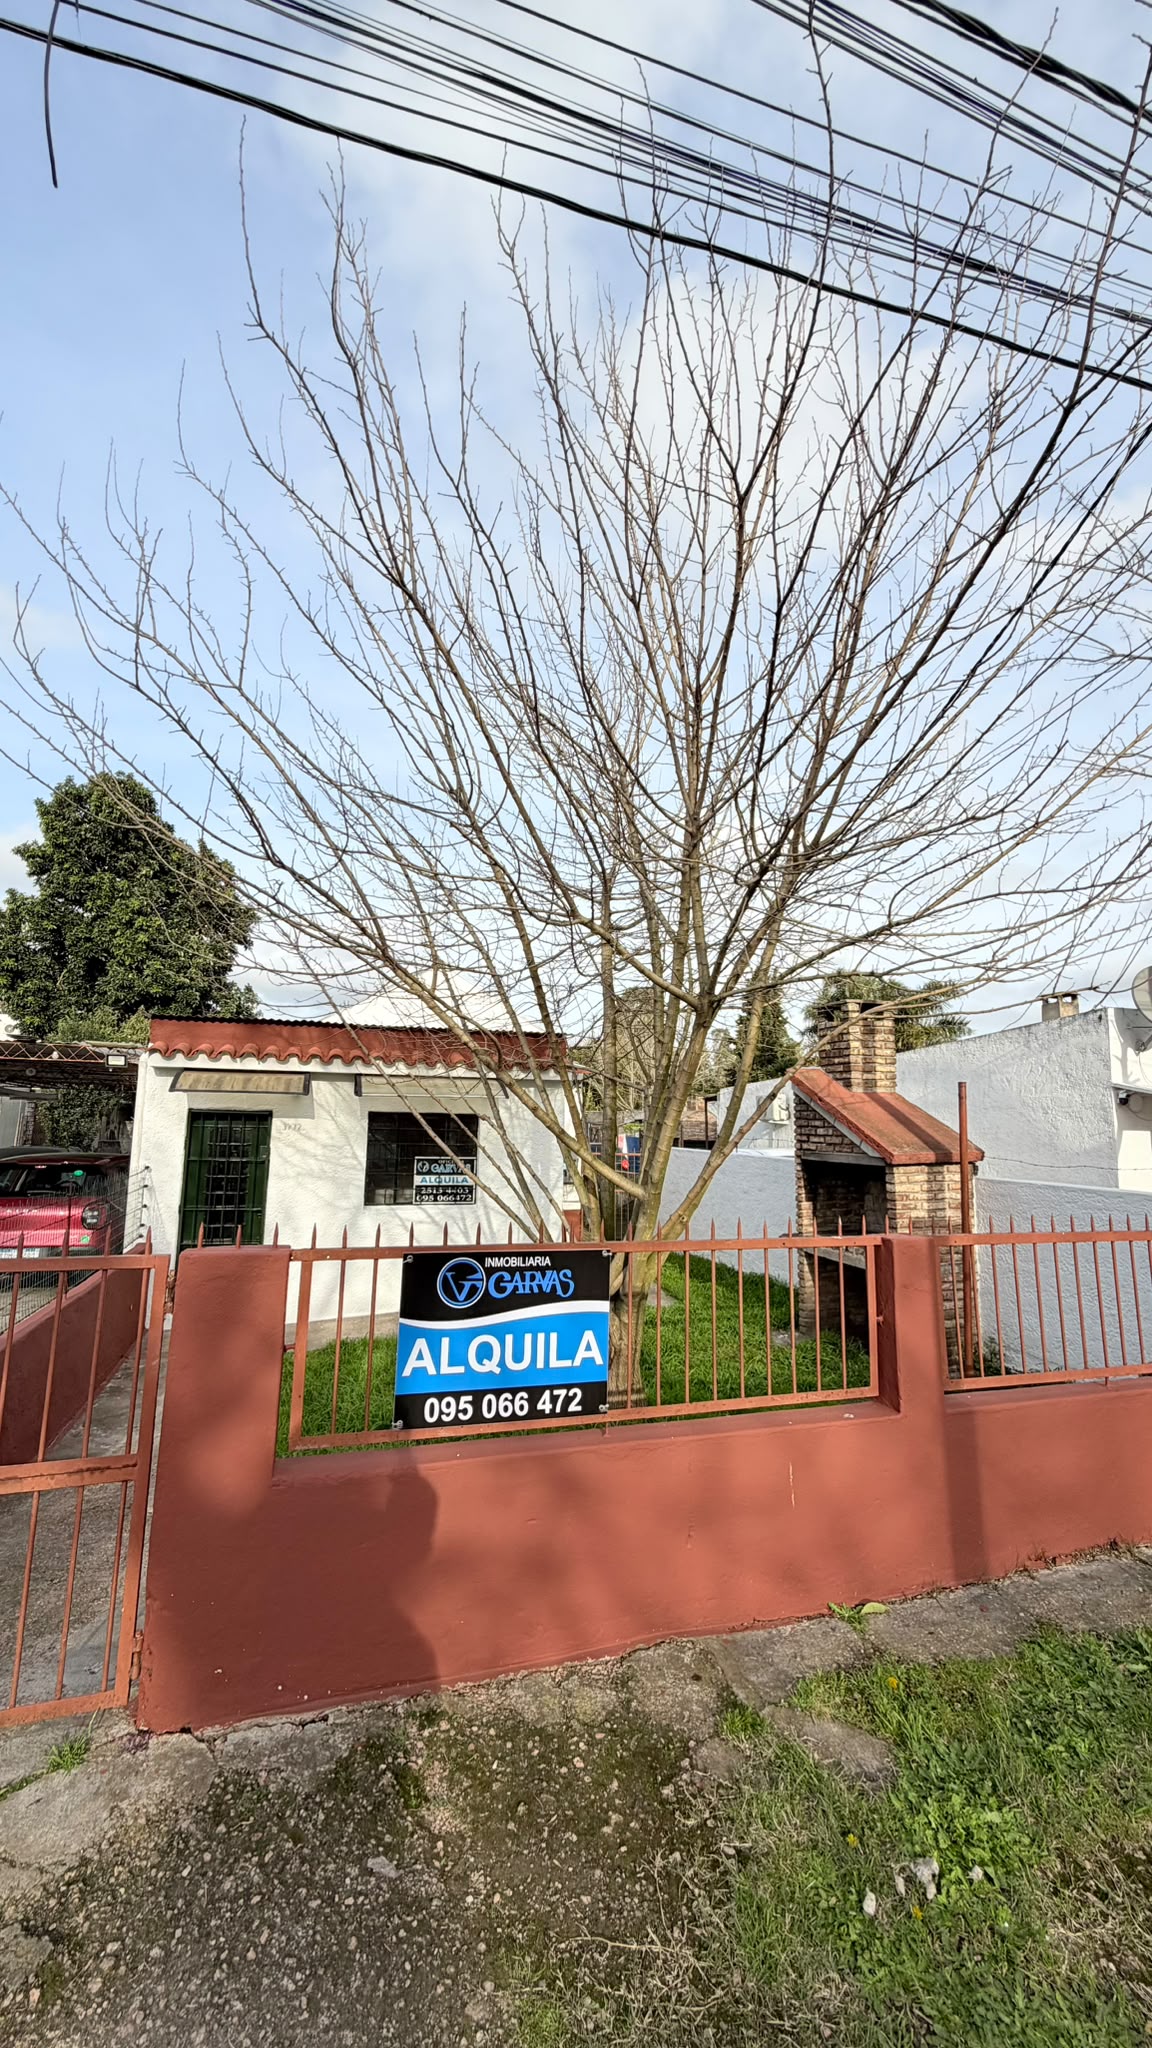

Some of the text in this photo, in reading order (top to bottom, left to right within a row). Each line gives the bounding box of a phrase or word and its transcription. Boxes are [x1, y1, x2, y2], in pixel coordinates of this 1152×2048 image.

[485, 1256, 551, 1268] INMOBILIARIA
[487, 1269, 575, 1299] GARVAS
[402, 1330, 604, 1377] ALQUILA
[424, 1387, 582, 1423] 095 066 472
